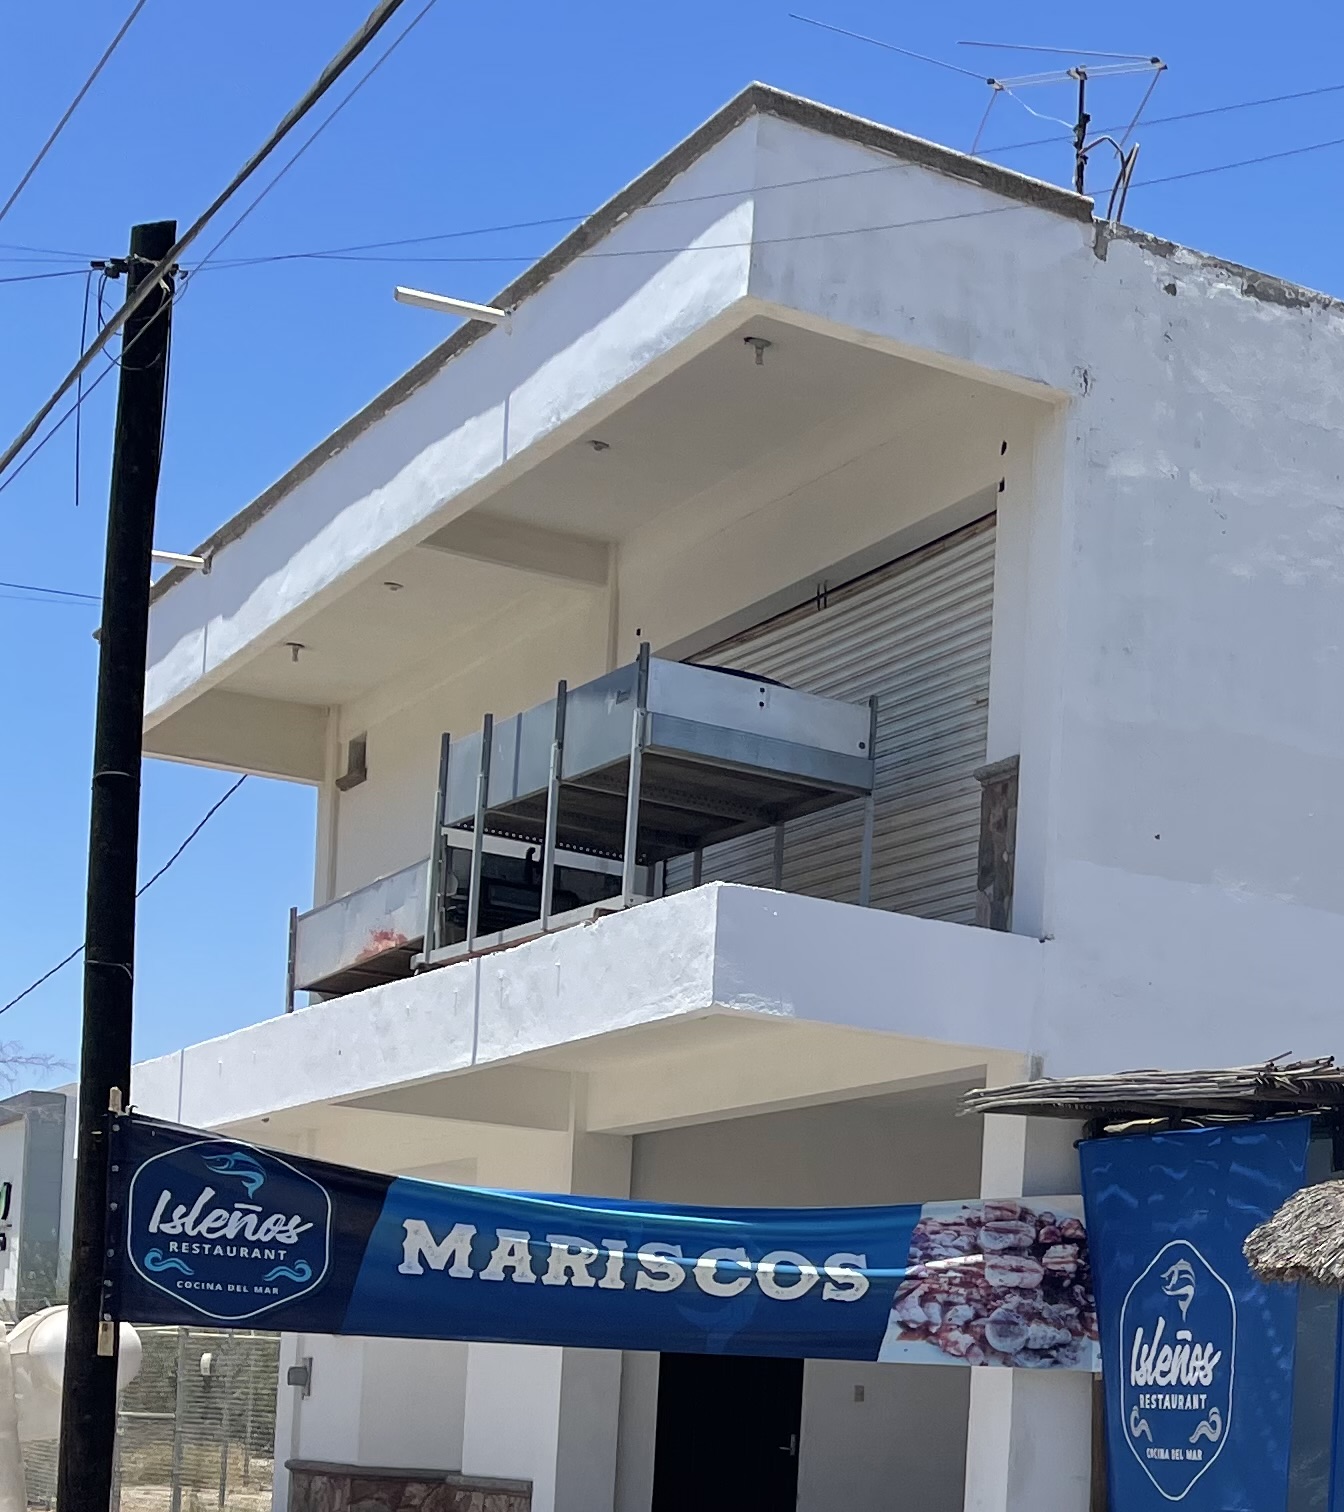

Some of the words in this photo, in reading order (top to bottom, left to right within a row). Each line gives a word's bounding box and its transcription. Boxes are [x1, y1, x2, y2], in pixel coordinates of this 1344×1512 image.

[148, 1186, 314, 1244] Isleños
[169, 1241, 287, 1261] RESTAURANT
[398, 1218, 870, 1302] MARISCOS
[176, 1280, 223, 1291] COCINA
[227, 1284, 250, 1293] DEL
[253, 1286, 279, 1295] MAR
[1131, 1316, 1222, 1387] Isleños
[1139, 1394, 1208, 1410] RESTAURANT
[1146, 1447, 1170, 1460] COCINA
[1171, 1448, 1184, 1461] DEL
[1186, 1449, 1203, 1461] MAR
